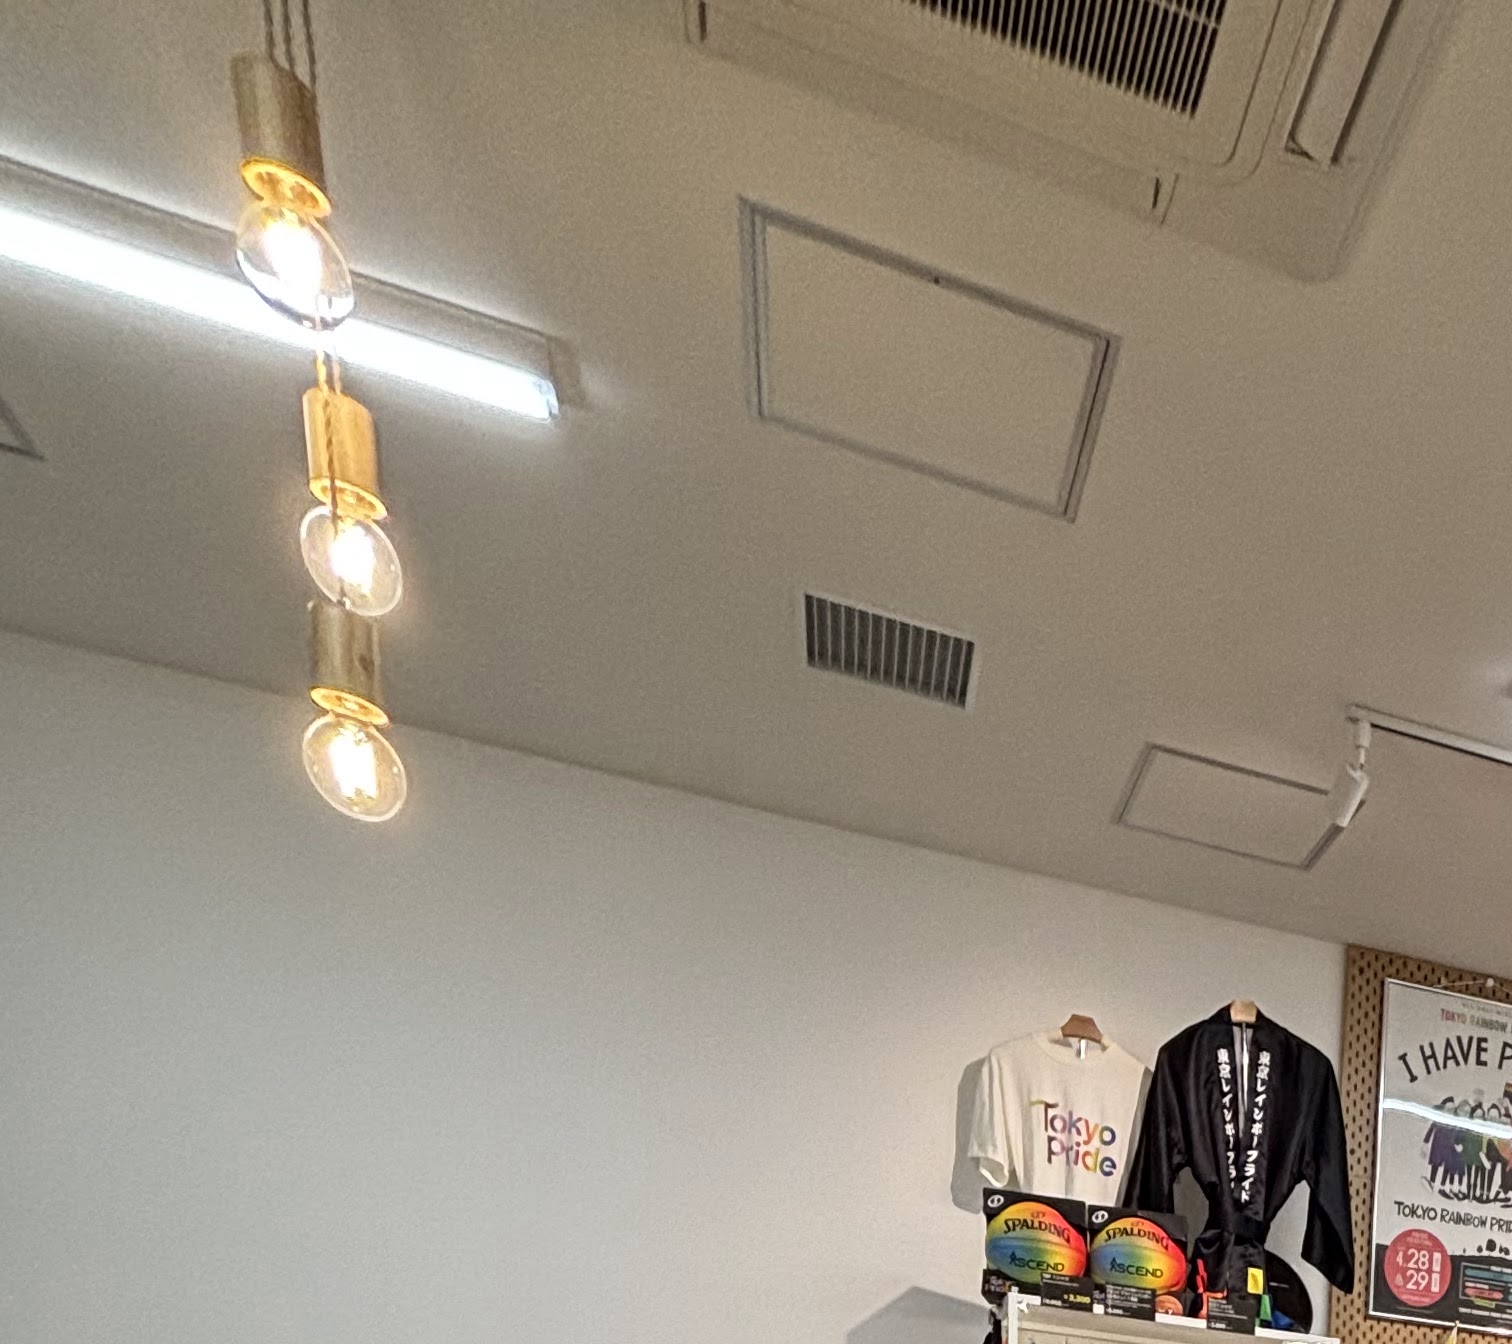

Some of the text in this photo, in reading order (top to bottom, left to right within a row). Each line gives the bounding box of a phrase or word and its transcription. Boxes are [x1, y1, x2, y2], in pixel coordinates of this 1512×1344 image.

[1398, 1052, 1418, 1083] I
[1419, 1035, 1488, 1075] HAVE
[1031, 1099, 1116, 1146] Tokyo
[1047, 1135, 1117, 1177] Pride
[1393, 1201, 1437, 1221] TOKYO
[1440, 1208, 1487, 1229] RAINBOW
[1004, 1218, 1071, 1245] SPALDING
[1105, 1228, 1169, 1251] SPALDING
[1009, 1252, 1064, 1272] ASCEND
[1110, 1257, 1163, 1279] ASCEND
[1406, 1270, 1429, 1291] 29
